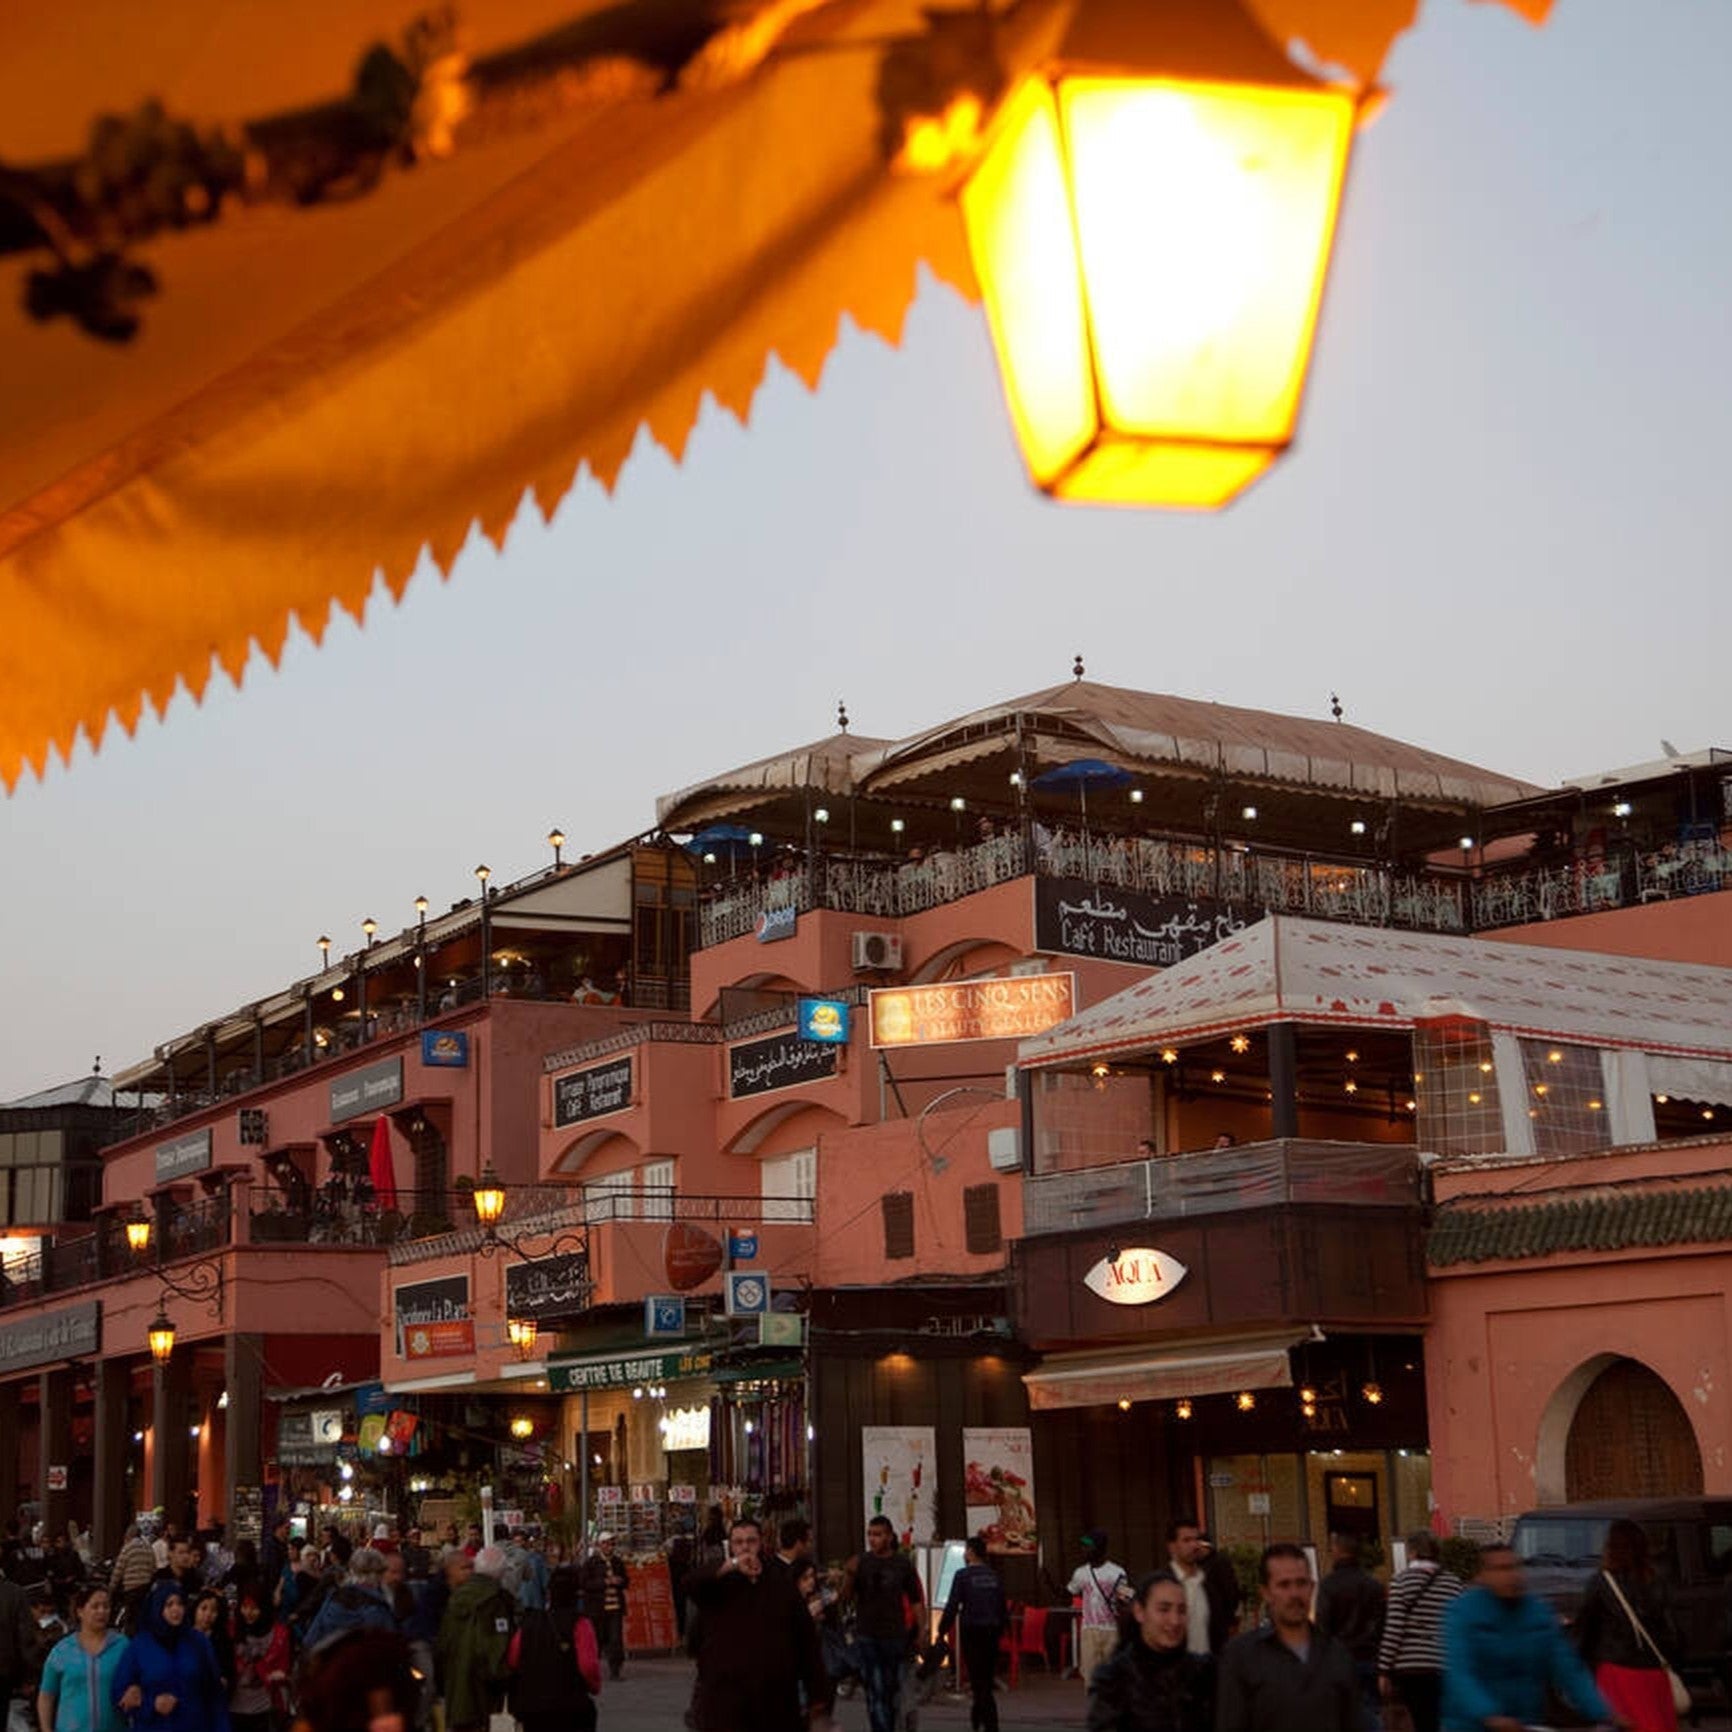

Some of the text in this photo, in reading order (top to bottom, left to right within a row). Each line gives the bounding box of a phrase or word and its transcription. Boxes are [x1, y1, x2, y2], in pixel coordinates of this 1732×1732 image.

[1061, 917, 1096, 952] Café
[1103, 925, 1183, 962] Restaurant
[914, 980, 1070, 1011] LES CINQ SENS
[1106, 1259, 1162, 1286] AQUA
[568, 1365, 608, 1386] CENTRE
[608, 1363, 623, 1382] DE
